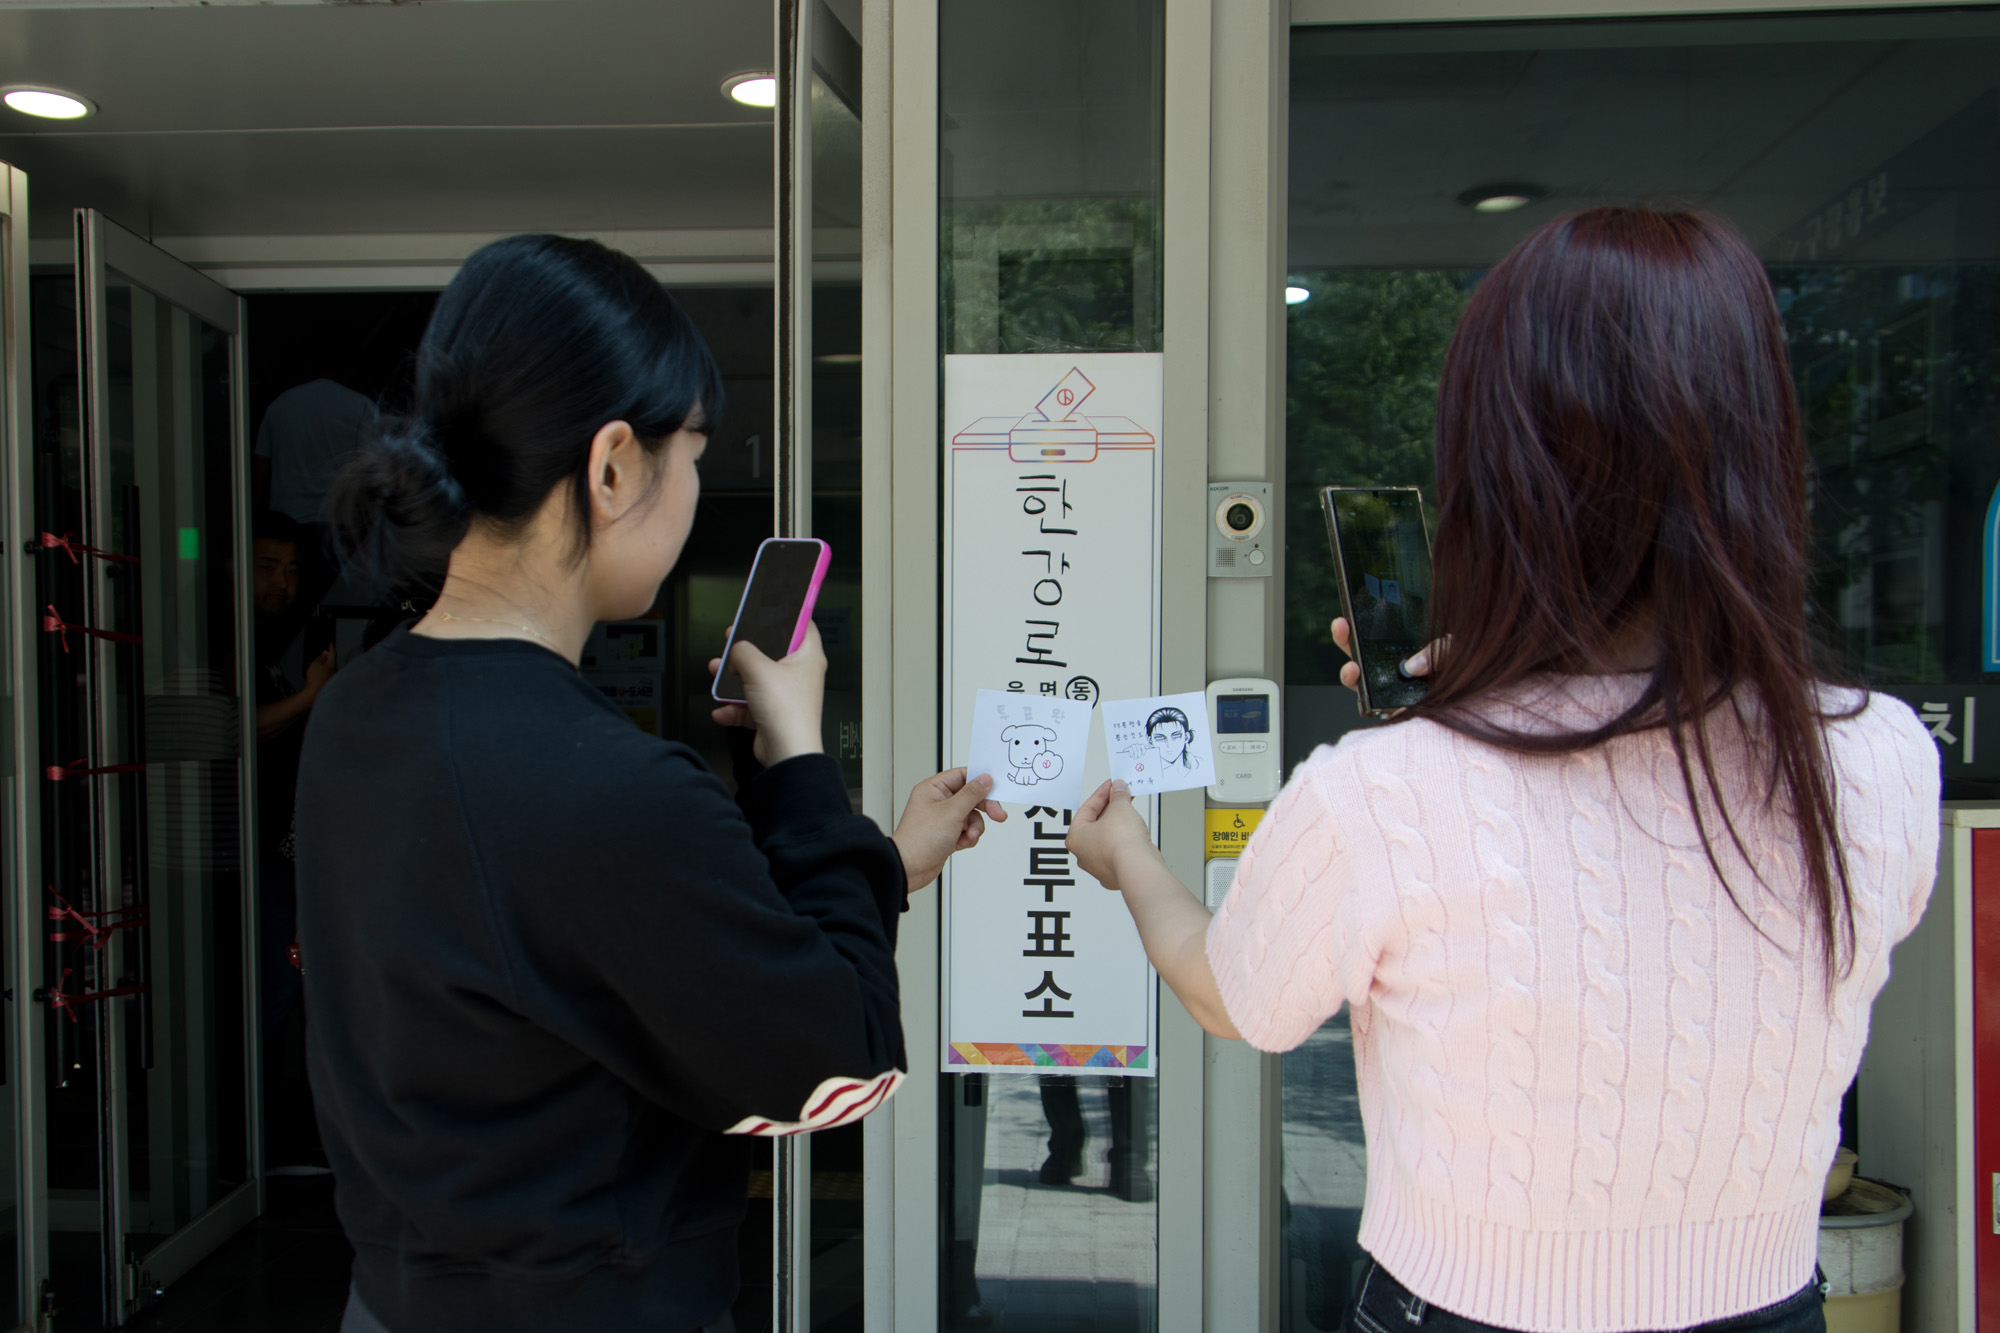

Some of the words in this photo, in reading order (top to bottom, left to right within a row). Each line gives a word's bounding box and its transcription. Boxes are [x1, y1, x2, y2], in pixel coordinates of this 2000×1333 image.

[745, 434, 761, 479] 1
[1016, 474, 1078, 668] 한강로
[1072, 681, 1091, 702] 동
[1212, 831, 1239, 841] 장애인
[1241, 831, 1253, 841] 비
